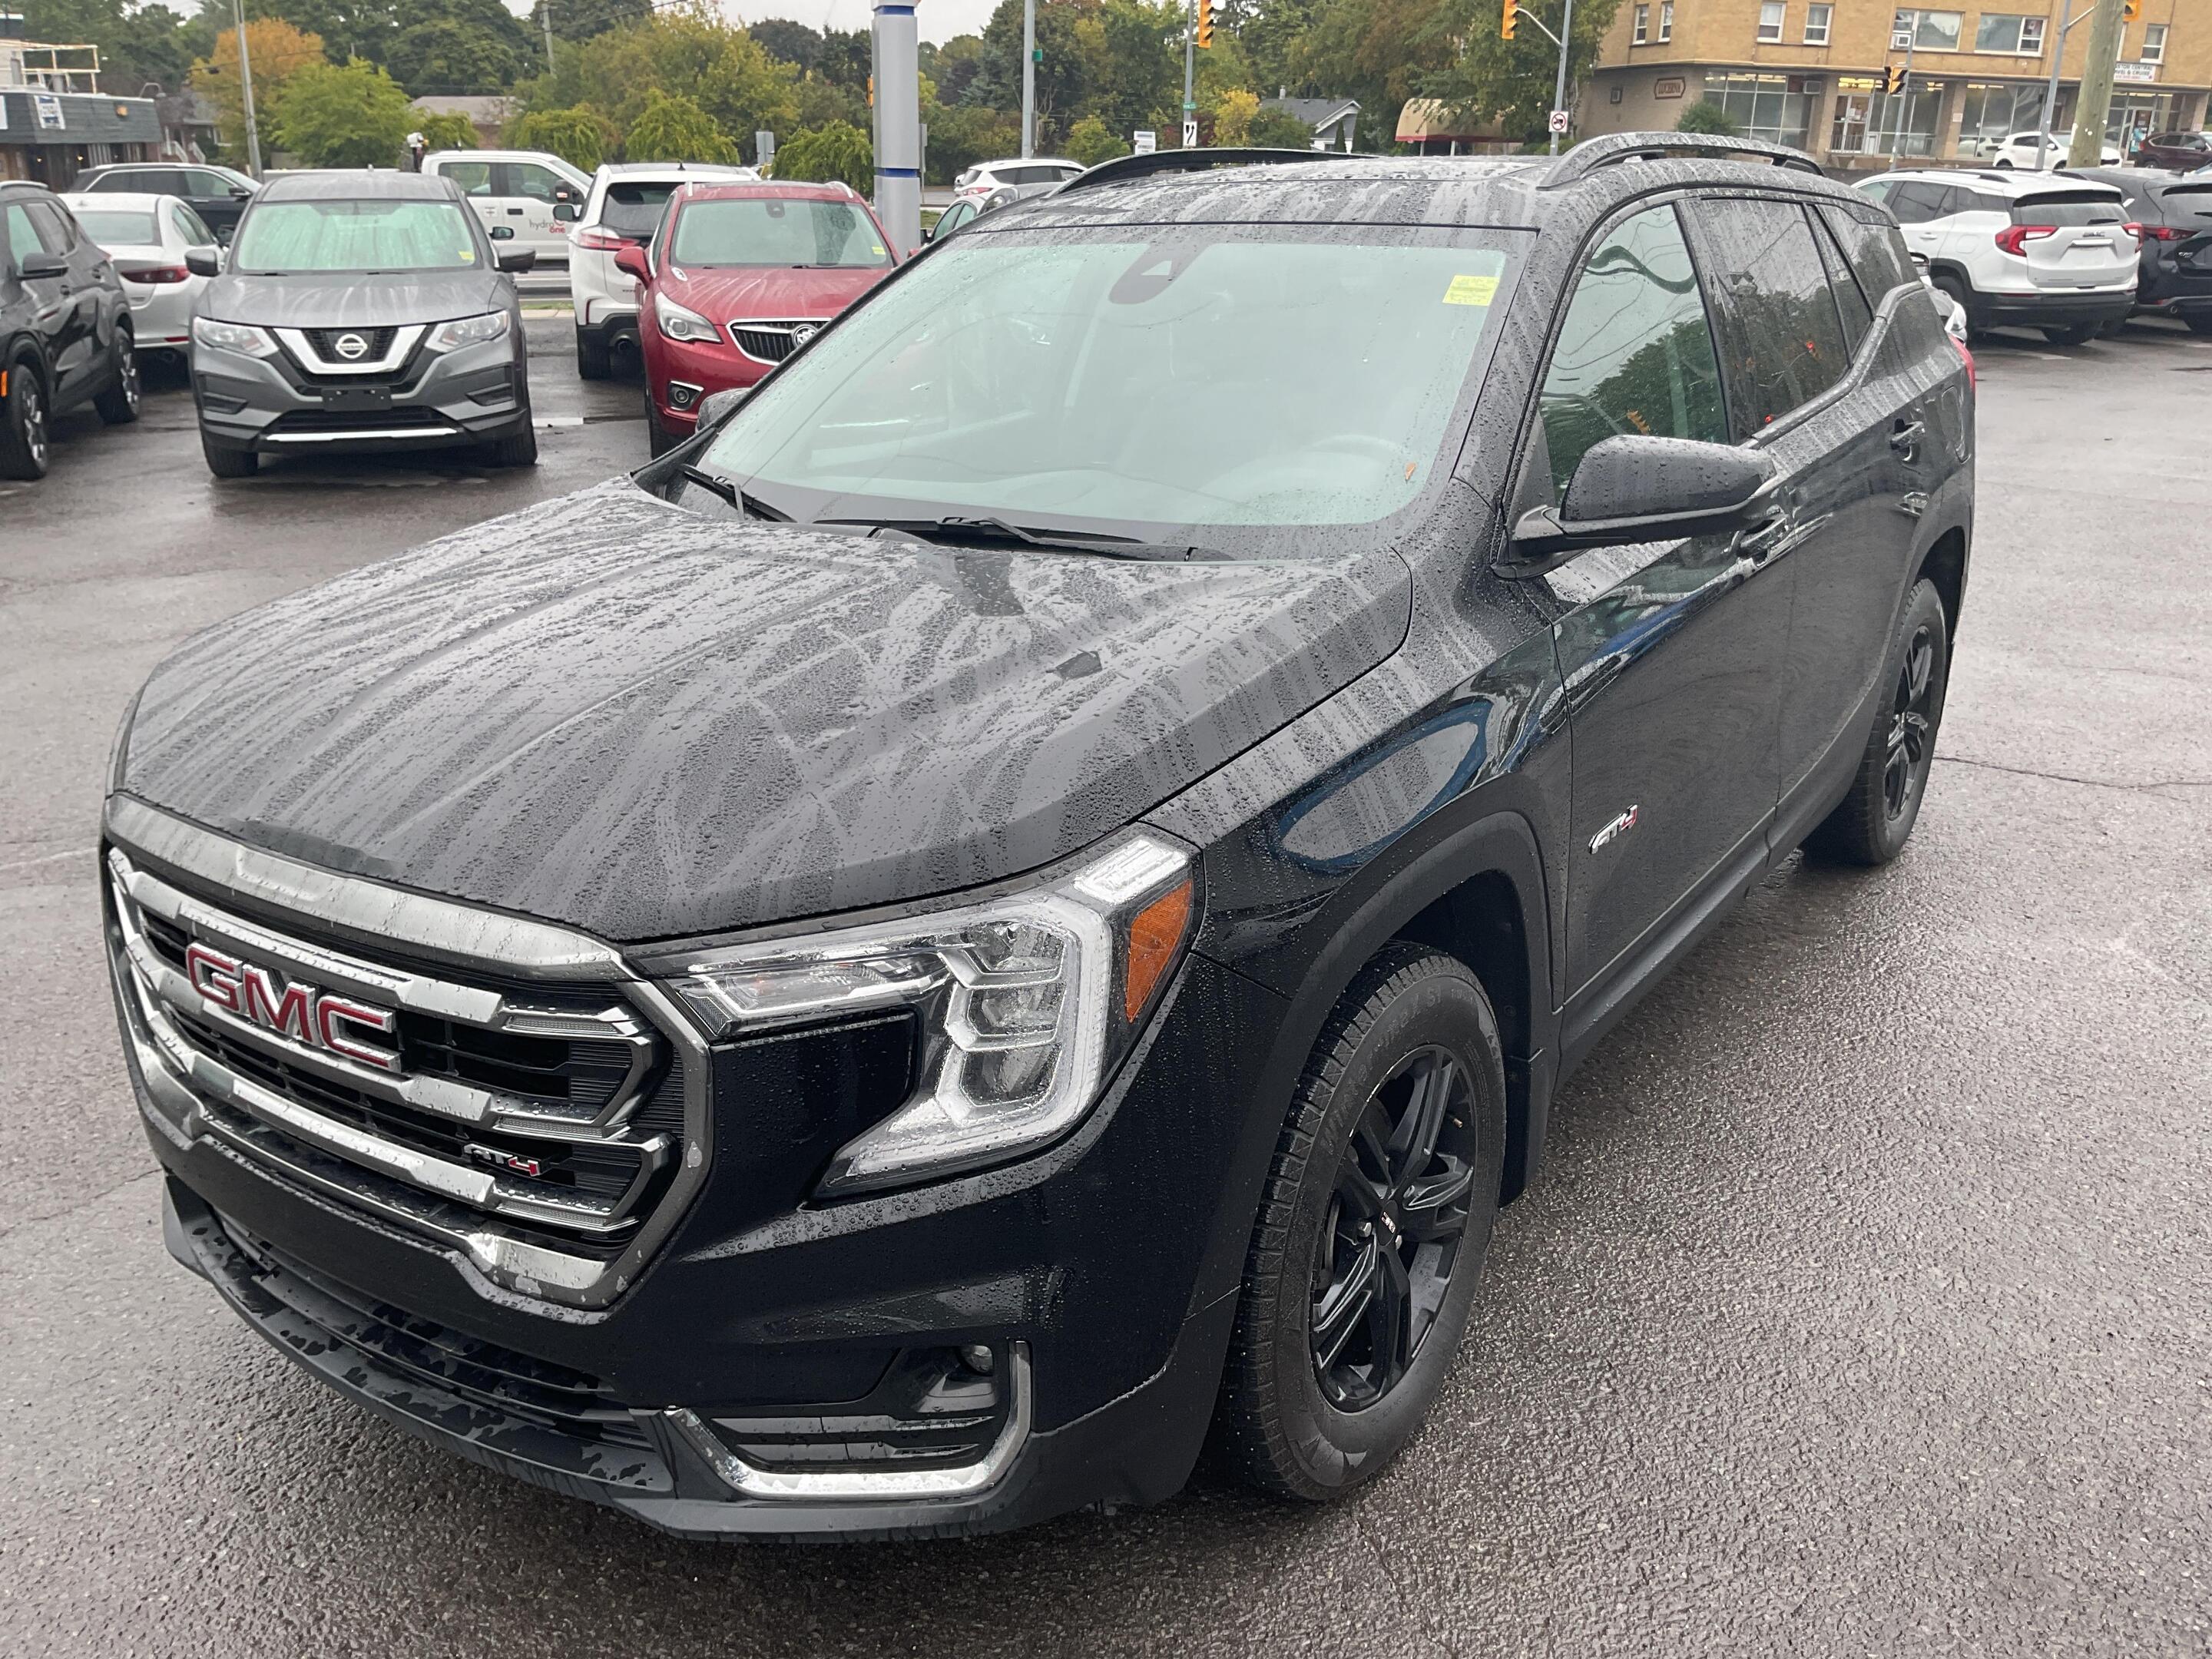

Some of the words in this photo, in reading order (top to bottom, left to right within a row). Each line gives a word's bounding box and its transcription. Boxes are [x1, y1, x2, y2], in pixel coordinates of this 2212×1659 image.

[528, 219, 555, 230] hydro
[185, 942, 403, 1074] GMC
[463, 1143, 541, 1177] AT4
